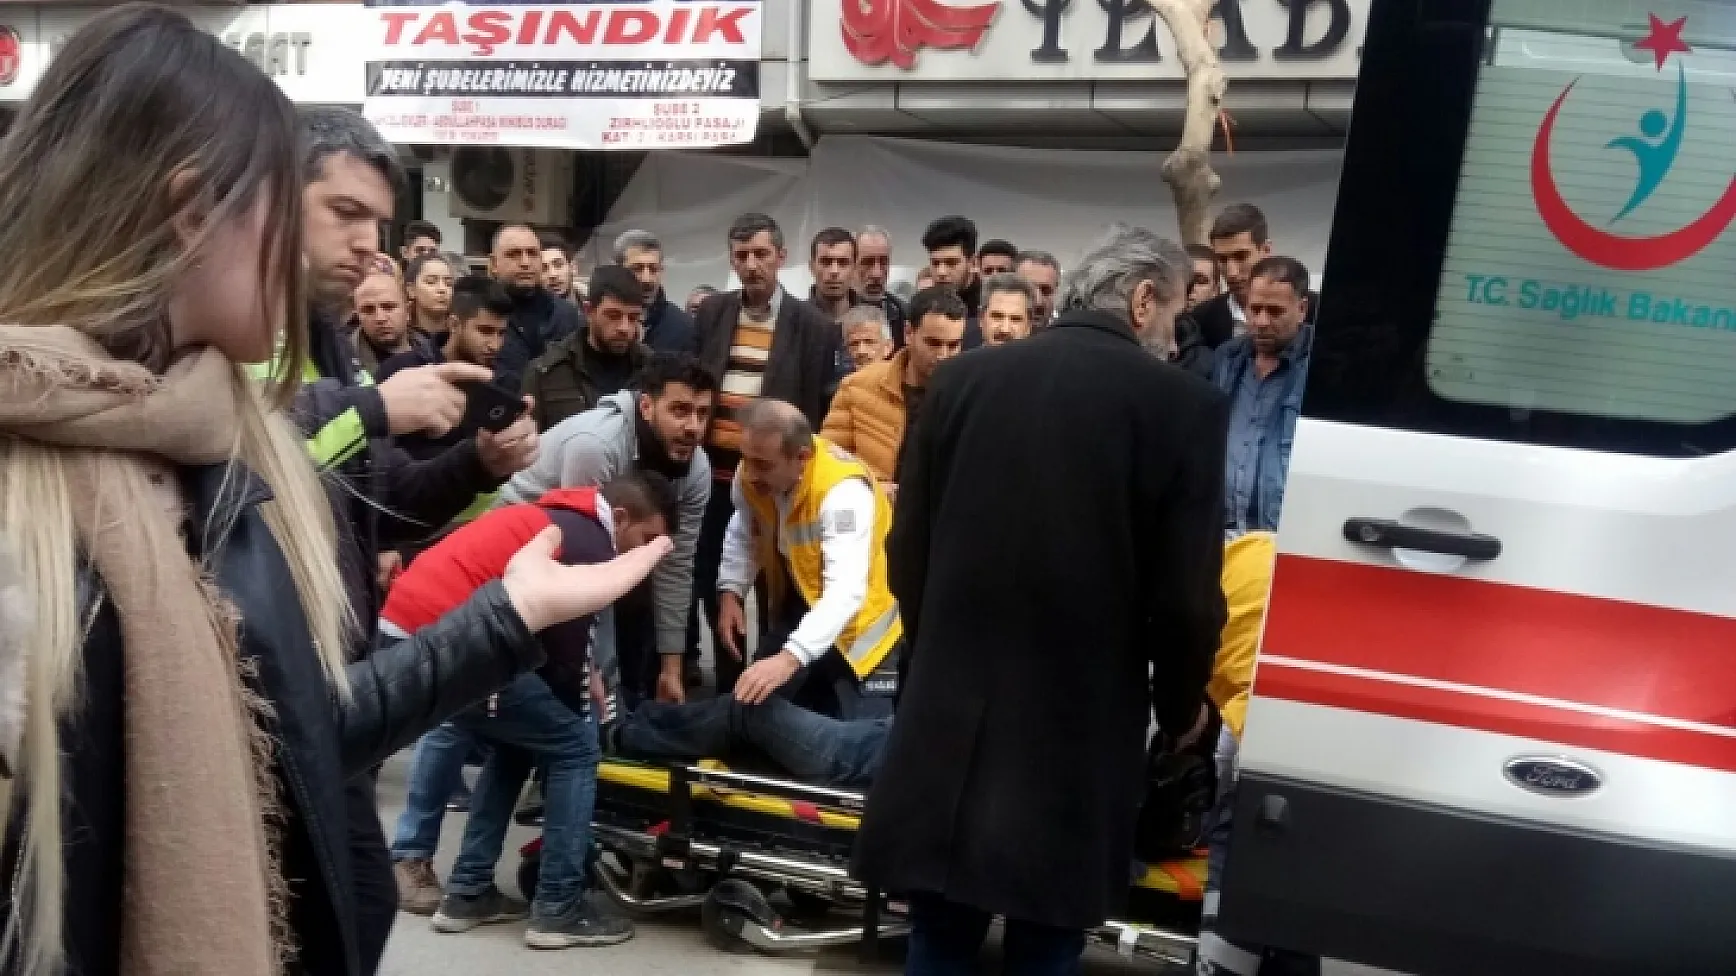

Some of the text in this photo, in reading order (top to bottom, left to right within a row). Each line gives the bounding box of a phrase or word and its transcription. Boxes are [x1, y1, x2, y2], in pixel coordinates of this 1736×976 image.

[379, 7, 757, 56] TAŞINDIK
[381, 62, 737, 94] YENİ ŞUBELERİMİZLE HİZMETİNİZDEYİZ
[1517, 279, 1617, 320] Sağlık
